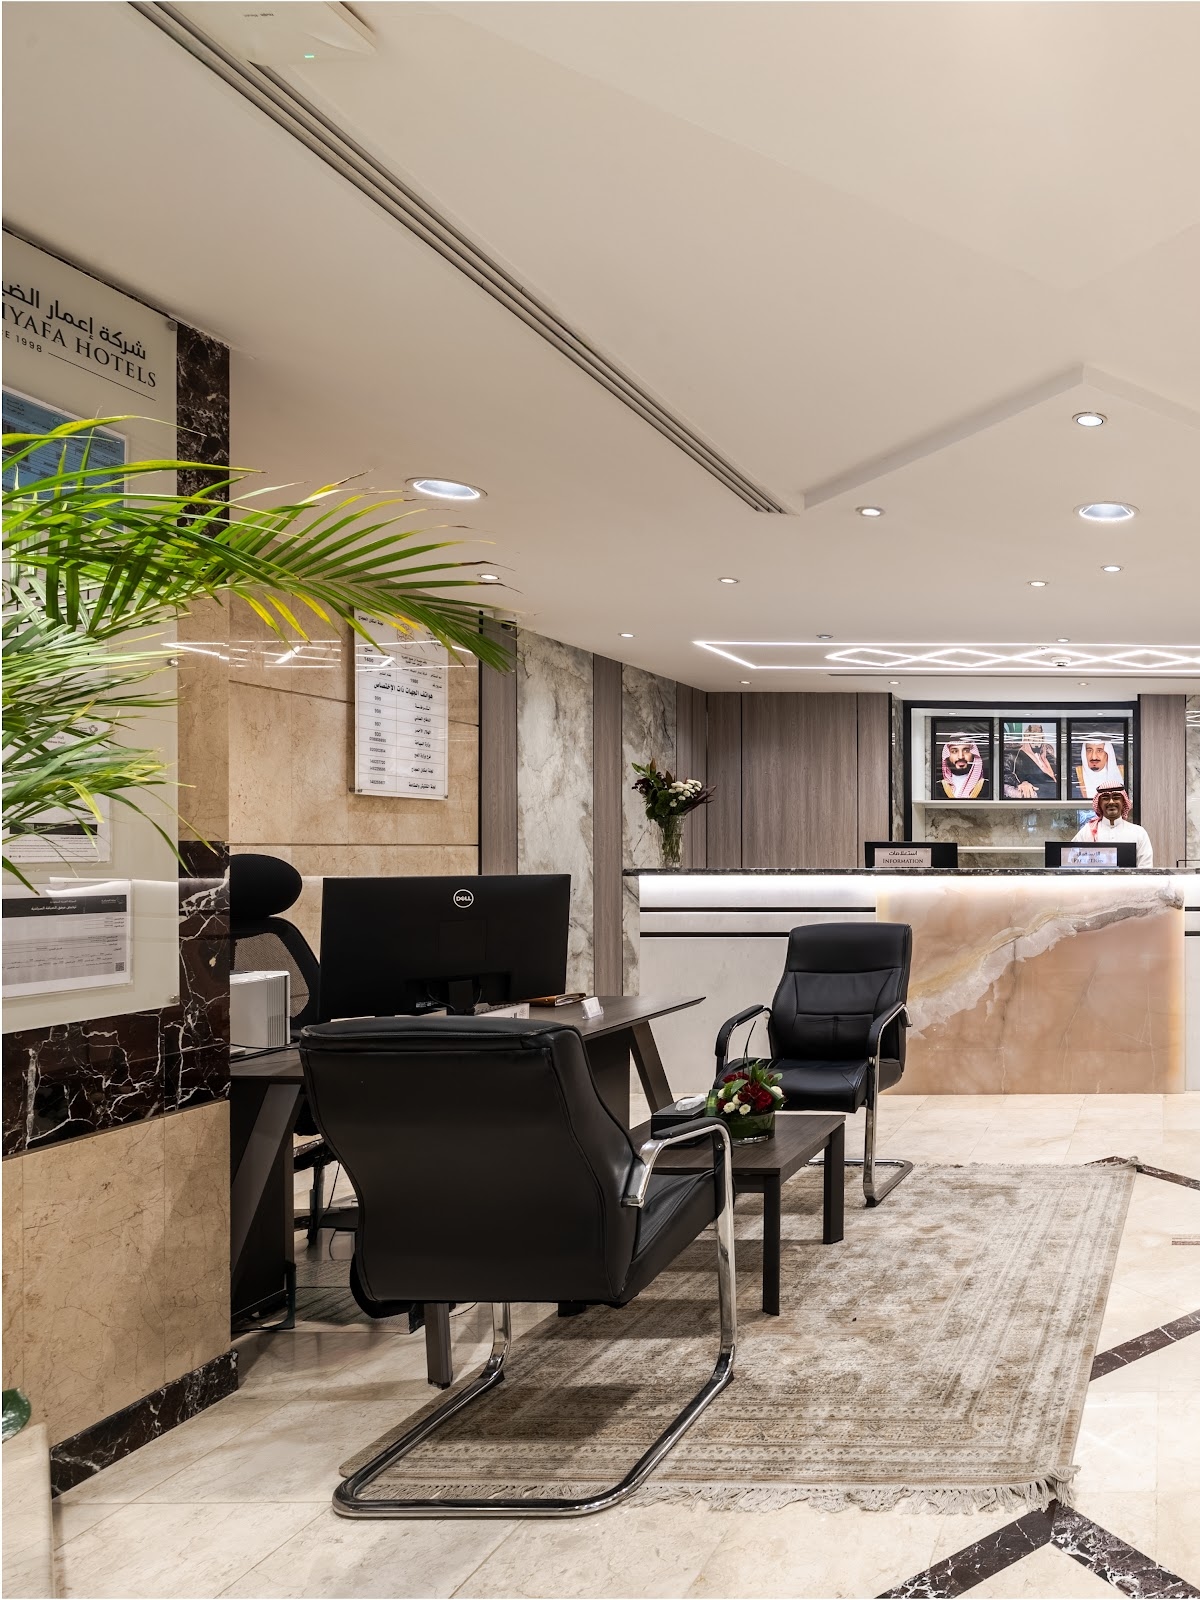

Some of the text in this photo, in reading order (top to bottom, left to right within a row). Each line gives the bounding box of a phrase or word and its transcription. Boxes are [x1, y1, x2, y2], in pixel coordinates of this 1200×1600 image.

[46, 300, 94, 340] إعمار
[15, 334, 42, 353] 1998
[99, 326, 146, 360] شركة
[75, 336, 156, 388] HOTELS
